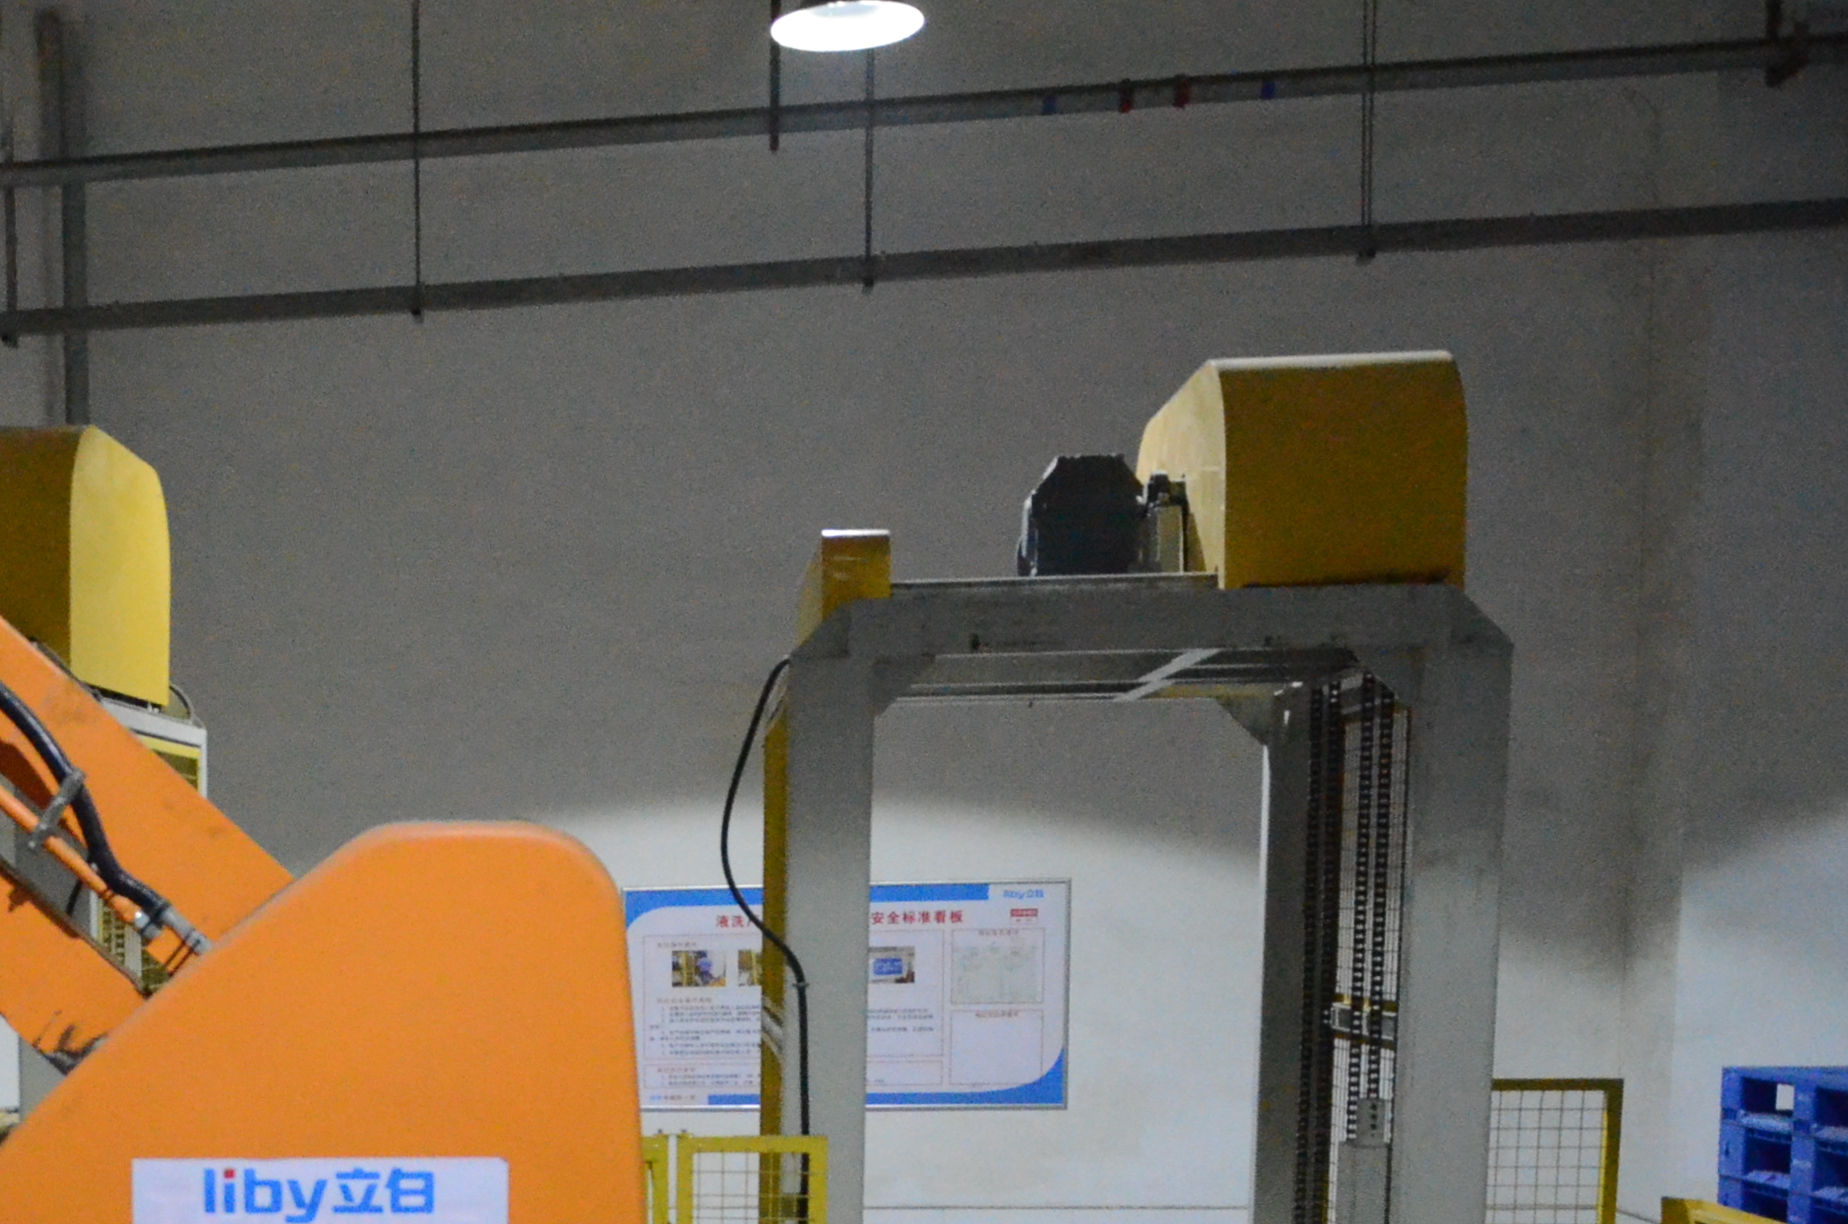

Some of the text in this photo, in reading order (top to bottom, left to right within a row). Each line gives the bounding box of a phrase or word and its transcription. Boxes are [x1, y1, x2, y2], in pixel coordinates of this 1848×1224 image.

[871, 909, 964, 925] 安全标准看板
